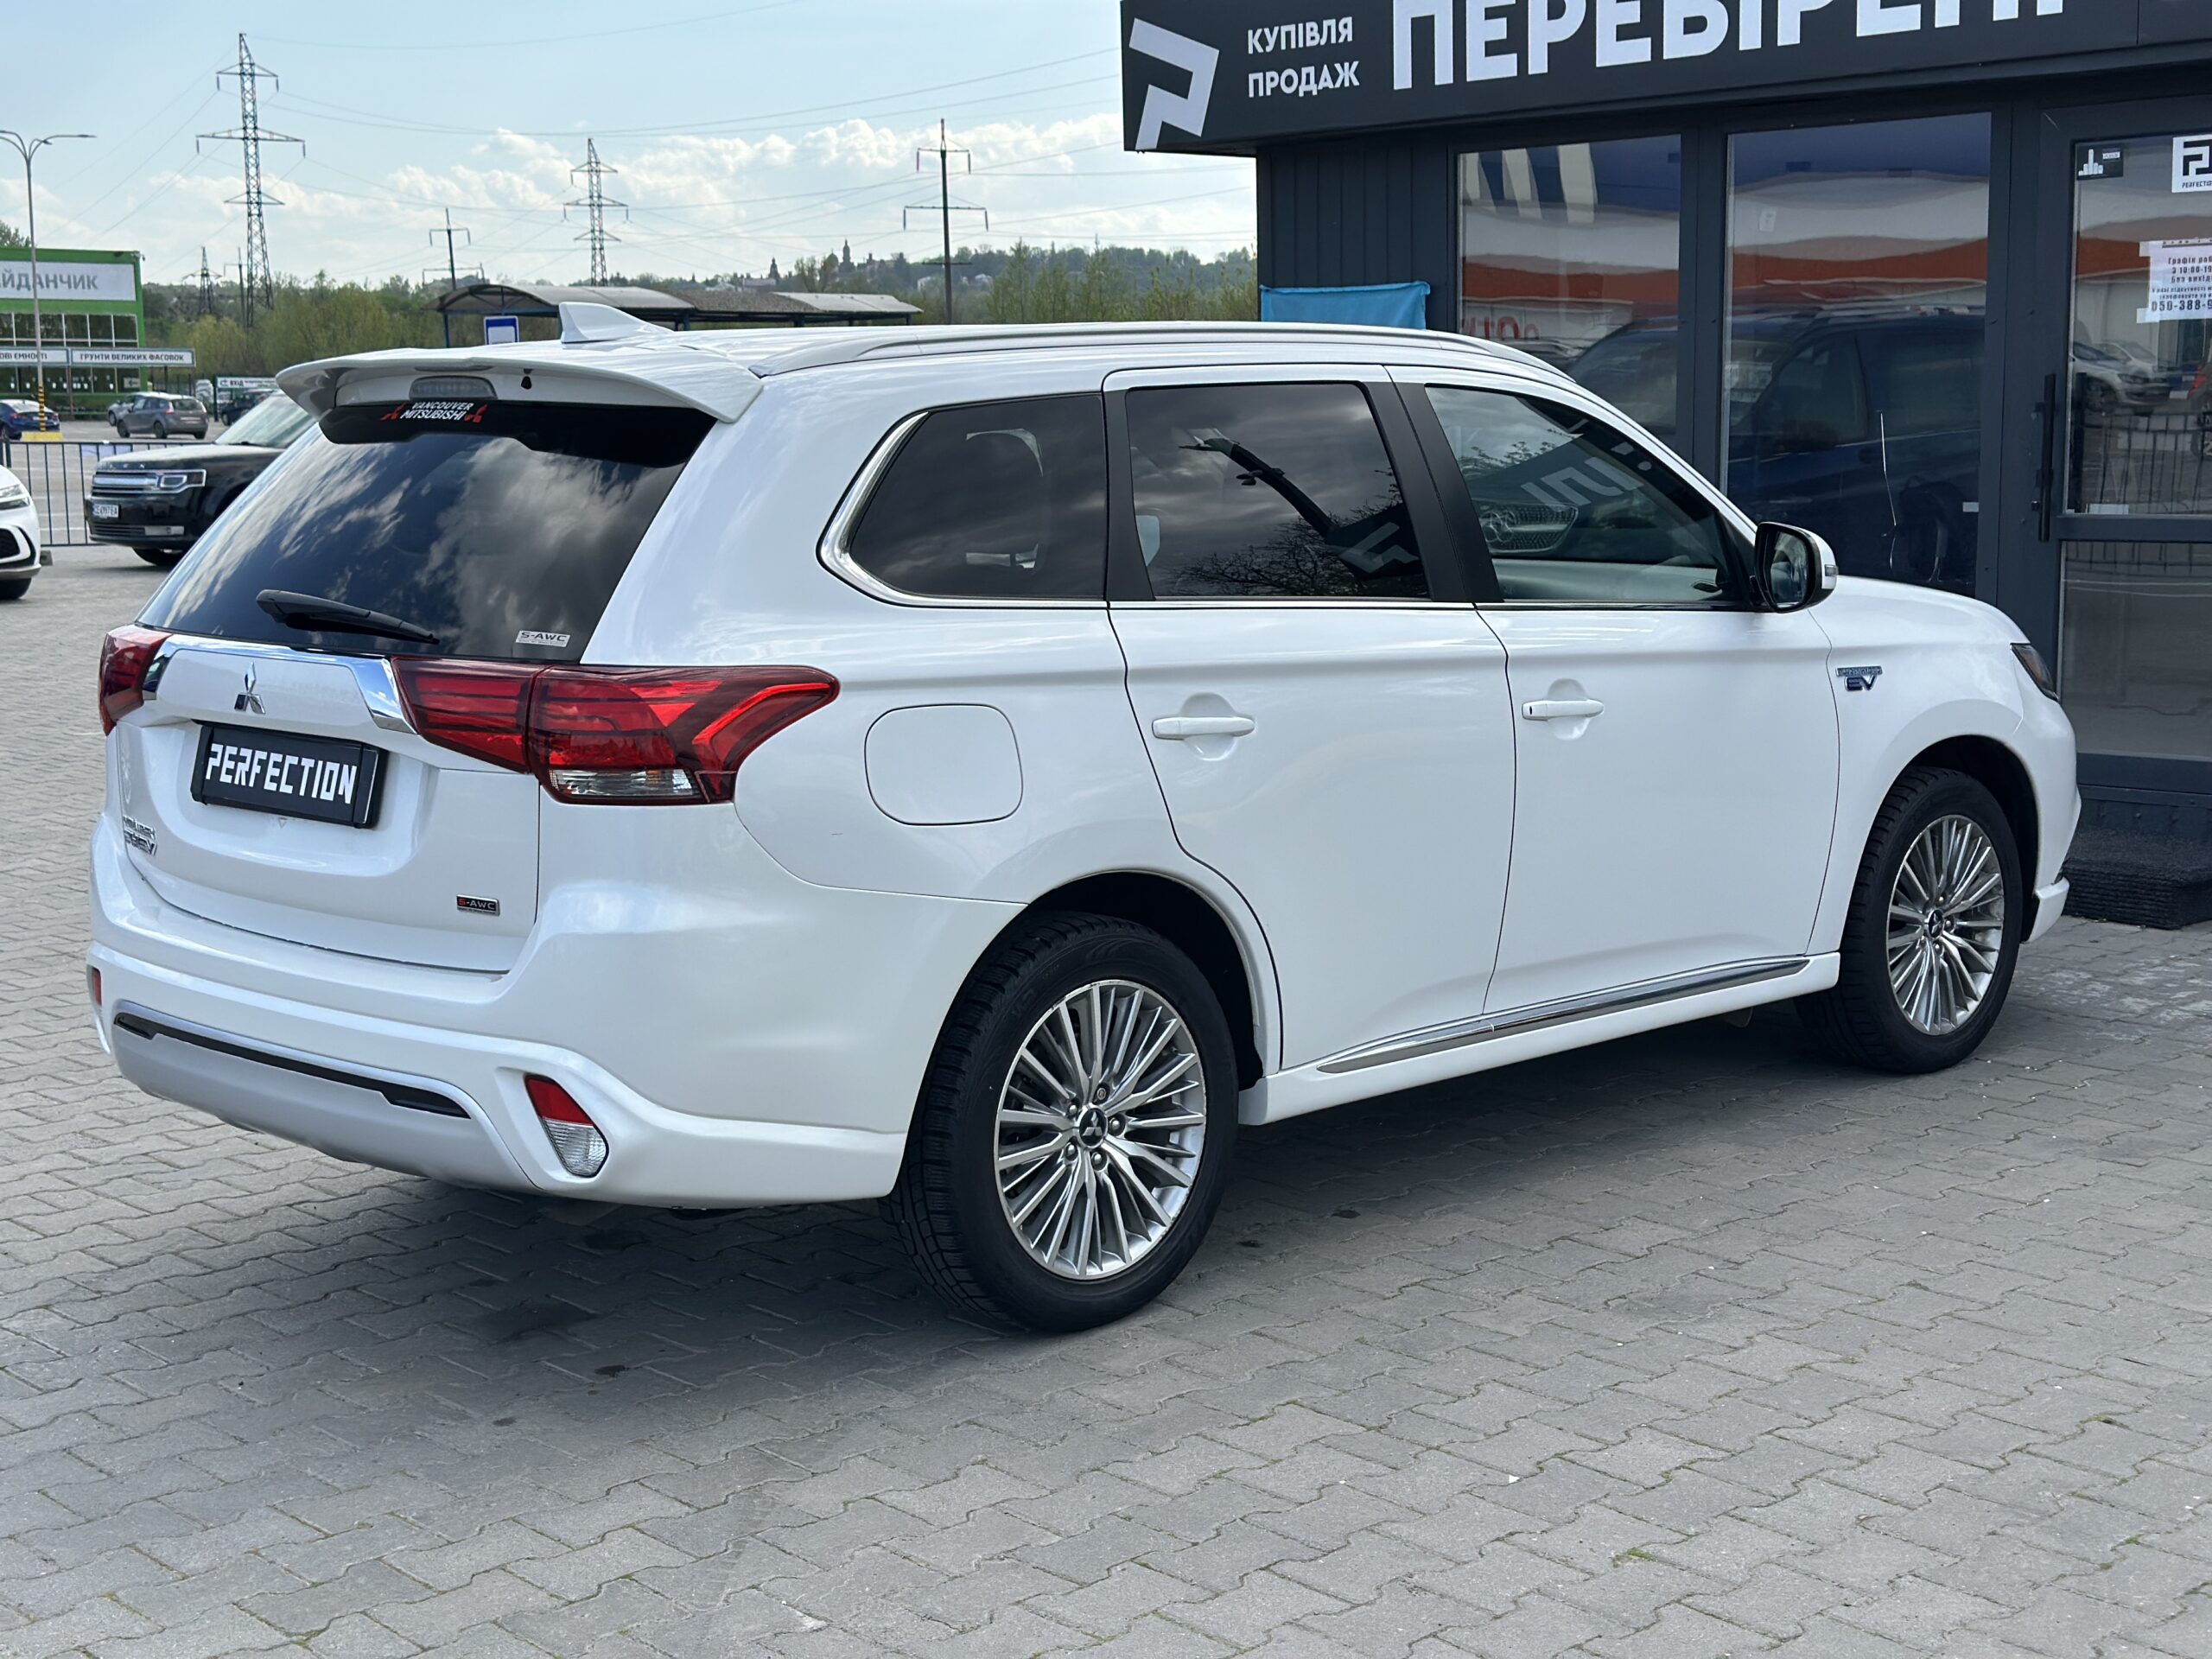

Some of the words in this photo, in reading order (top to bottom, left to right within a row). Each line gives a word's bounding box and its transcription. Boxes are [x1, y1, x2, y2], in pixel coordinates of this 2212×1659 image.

[1248, 16, 1353, 54] КУПІВЛЯ
[1248, 60, 1360, 98] ПРОДАЖ
[2168, 257, 2196, 265] Графік
[0, 269, 99, 291] ЙДАНЧИК
[2189, 274, 2212, 283] вихід
[14, 352, 48, 360] ЄМНОТІ
[412, 401, 474, 410] VANCOUVER
[399, 409, 467, 421] MITSUBISHI
[521, 632, 567, 642] S-AWC
[1844, 674, 1877, 691] EV
[206, 743, 357, 804] PERFECTION
[458, 899, 495, 910] S-AWC
